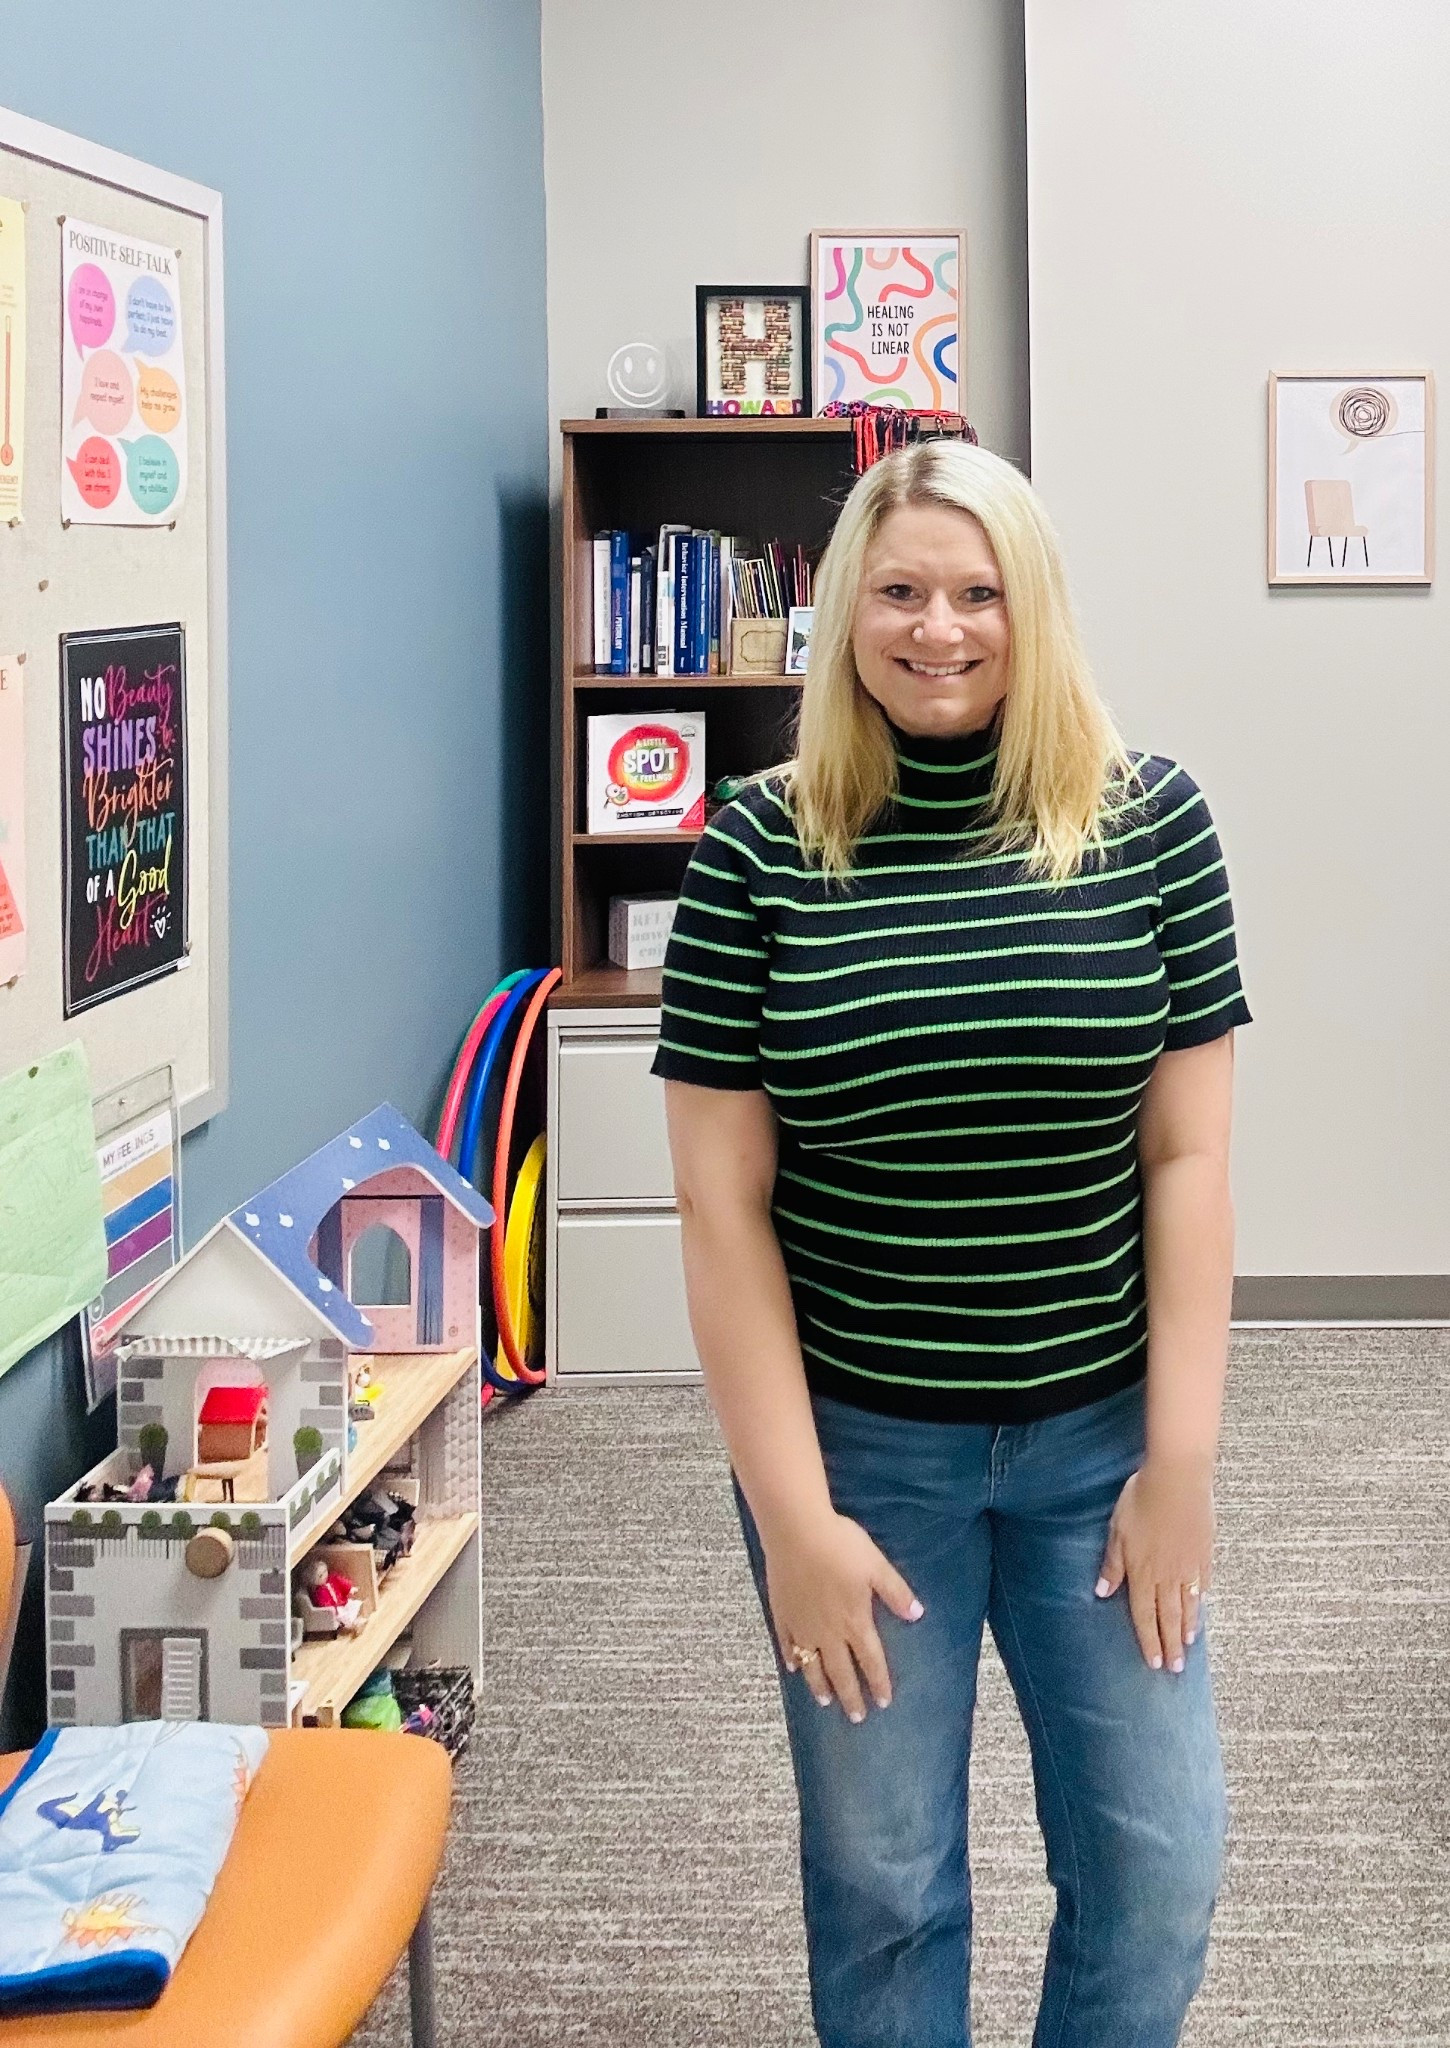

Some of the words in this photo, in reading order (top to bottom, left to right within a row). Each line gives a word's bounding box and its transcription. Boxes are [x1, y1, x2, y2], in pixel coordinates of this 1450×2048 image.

[69, 230, 117, 261] POSITIVE
[119, 246, 171, 275] SELF-TALK
[868, 305, 914, 318] HEALING
[872, 323, 883, 336] IS
[888, 323, 909, 336] NOT
[872, 342, 910, 354] LINEAR
[707, 400, 802, 415] HOWARD
[680, 542, 689, 574] Behavior
[680, 575, 689, 619] Intervention
[680, 620, 688, 648] Manual
[80, 677, 106, 722] NO
[104, 664, 176, 728] Beauty
[623, 747, 679, 774] SPOT
[640, 774, 672, 783] FEELINGS
[82, 754, 174, 847] Brighter
[86, 824, 128, 870] THAN
[136, 812, 176, 855] THAT
[86, 875, 100, 903] OF
[105, 869, 114, 898] A
[118, 834, 172, 930] Good
[86, 892, 168, 982] Heart
[103, 1151, 115, 1168] MY
